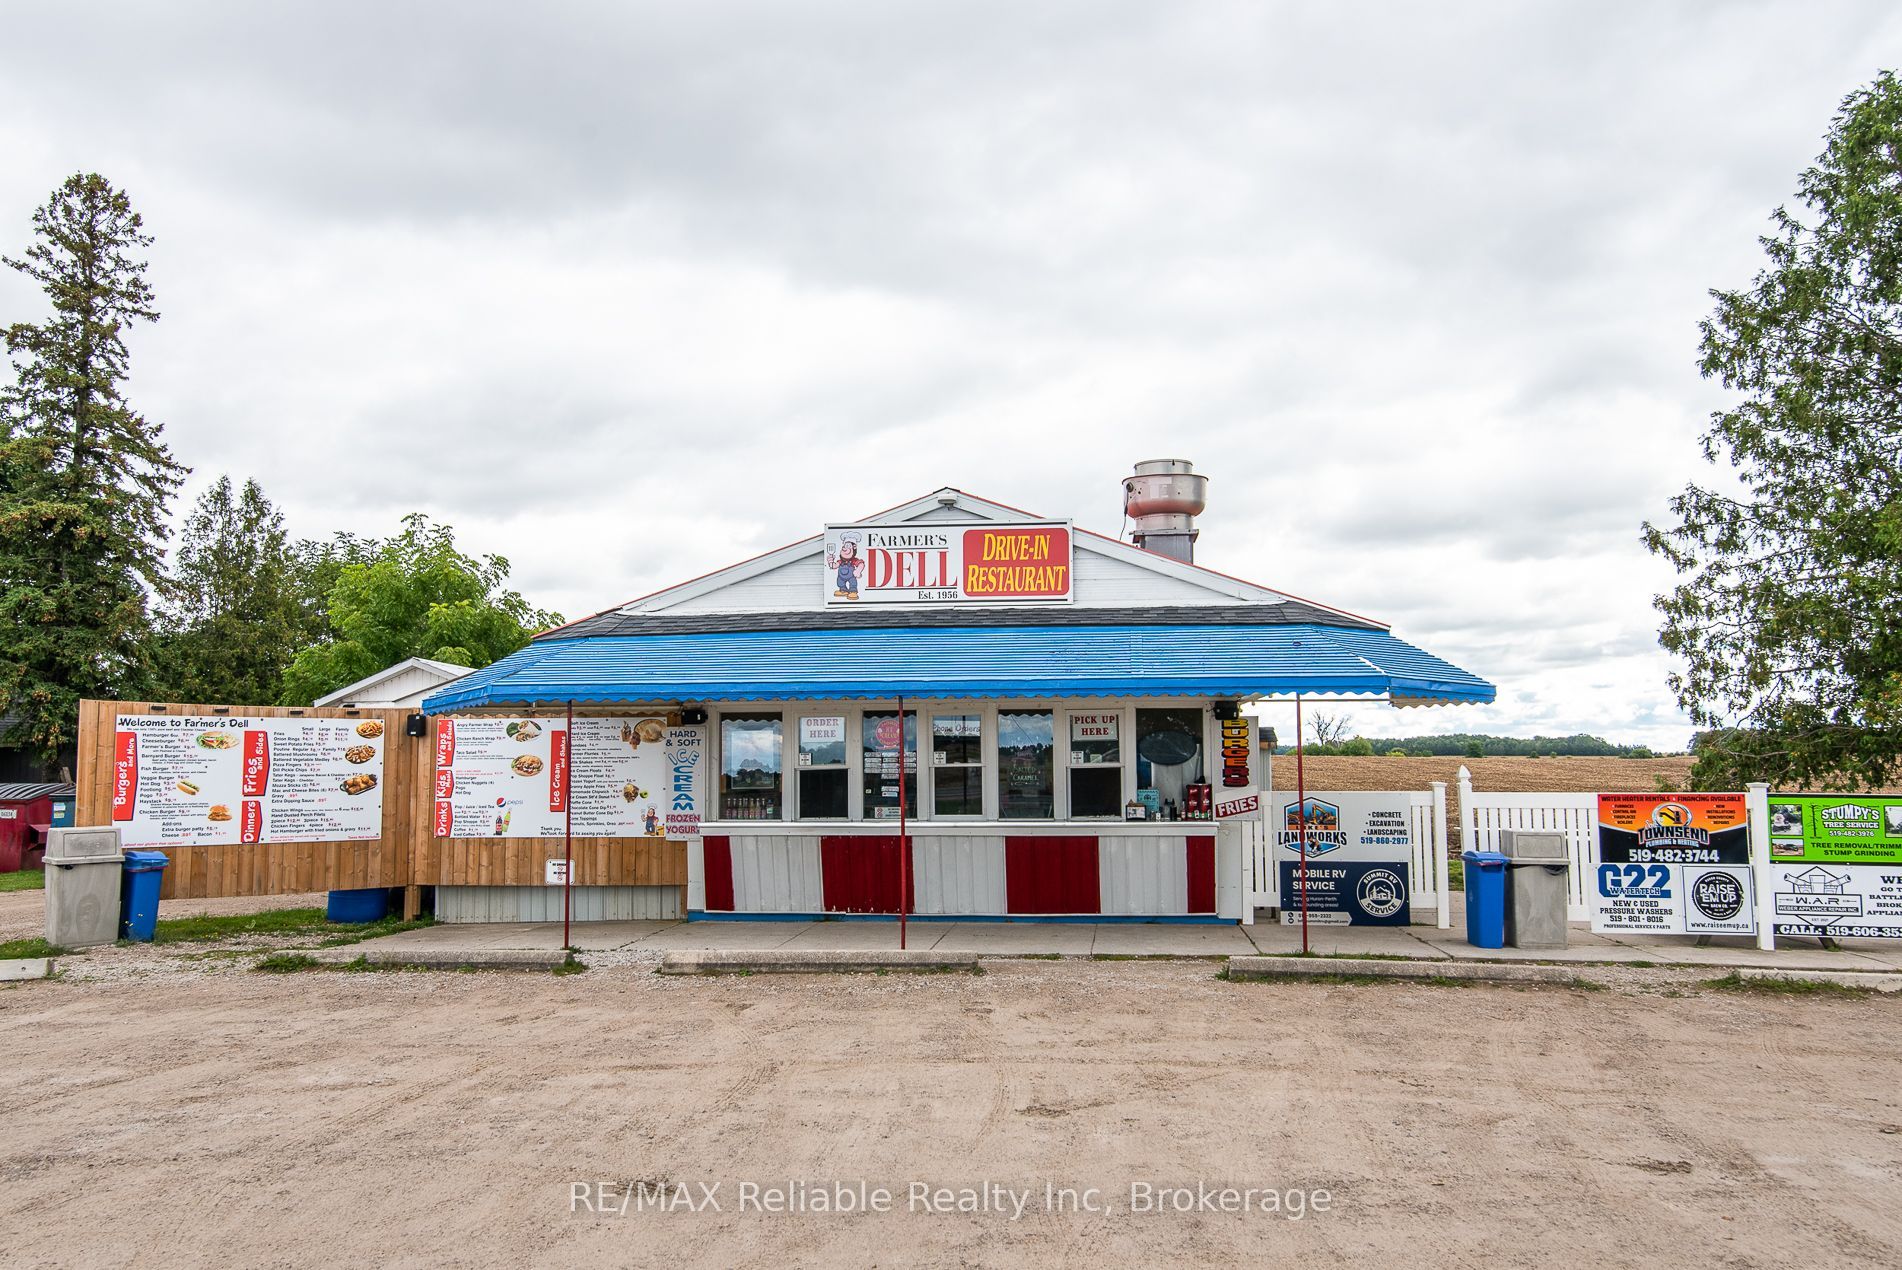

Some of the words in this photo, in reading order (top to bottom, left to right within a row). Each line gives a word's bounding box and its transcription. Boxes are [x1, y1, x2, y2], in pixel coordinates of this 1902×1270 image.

[867, 533, 948, 547] FARMER'S
[982, 532, 1051, 561] DRIVE-IN
[865, 548, 958, 588] DELL
[966, 564, 1066, 593] RESTAURANT
[918, 591, 934, 600] Est.
[937, 590, 958, 600] 1956
[118, 718, 167, 727] Welcome
[170, 718, 181, 727] to
[184, 718, 226, 728] Farmer's
[229, 719, 249, 727] Dell
[806, 718, 839, 727] ORDER
[1074, 716, 1098, 724] PICK
[1102, 715, 1115, 724] UP
[809, 730, 837, 738] HERE
[1081, 727, 1109, 736] HERE
[256, 732, 264, 755] Sides
[437, 733, 446, 765] Wraps
[667, 749, 700, 766] ICE
[1221, 718, 1250, 787] BURGERS
[243, 758, 258, 794] Fries
[437, 775, 446, 797] Kids
[672, 766, 694, 811] CREAM
[550, 791, 560, 806] Ice
[1218, 797, 1258, 817] FRIES
[1821, 803, 1880, 820] STUMPY'S
[243, 801, 256, 842] Dinners
[437, 802, 448, 836] Drinks
[666, 814, 700, 822] FROZEN
[1638, 826, 1710, 844] TOWNSEND
[1332, 870, 1347, 878] RV
[1363, 872, 1389, 884] SUMMIT
[1388, 874, 1398, 884] RV
[1597, 864, 1672, 898] G22
[1609, 887, 1662, 895] WATERTECH
[1700, 883, 1736, 894] RAISE
[1720, 894, 1737, 903] UP
[1795, 897, 1839, 905] W.A.R
[1365, 902, 1398, 914] SERVICE
[1600, 907, 1636, 915] PRESSURE
[1690, 922, 1749, 930] www.raiseemup.ca
[1780, 925, 1822, 935] CALL:
